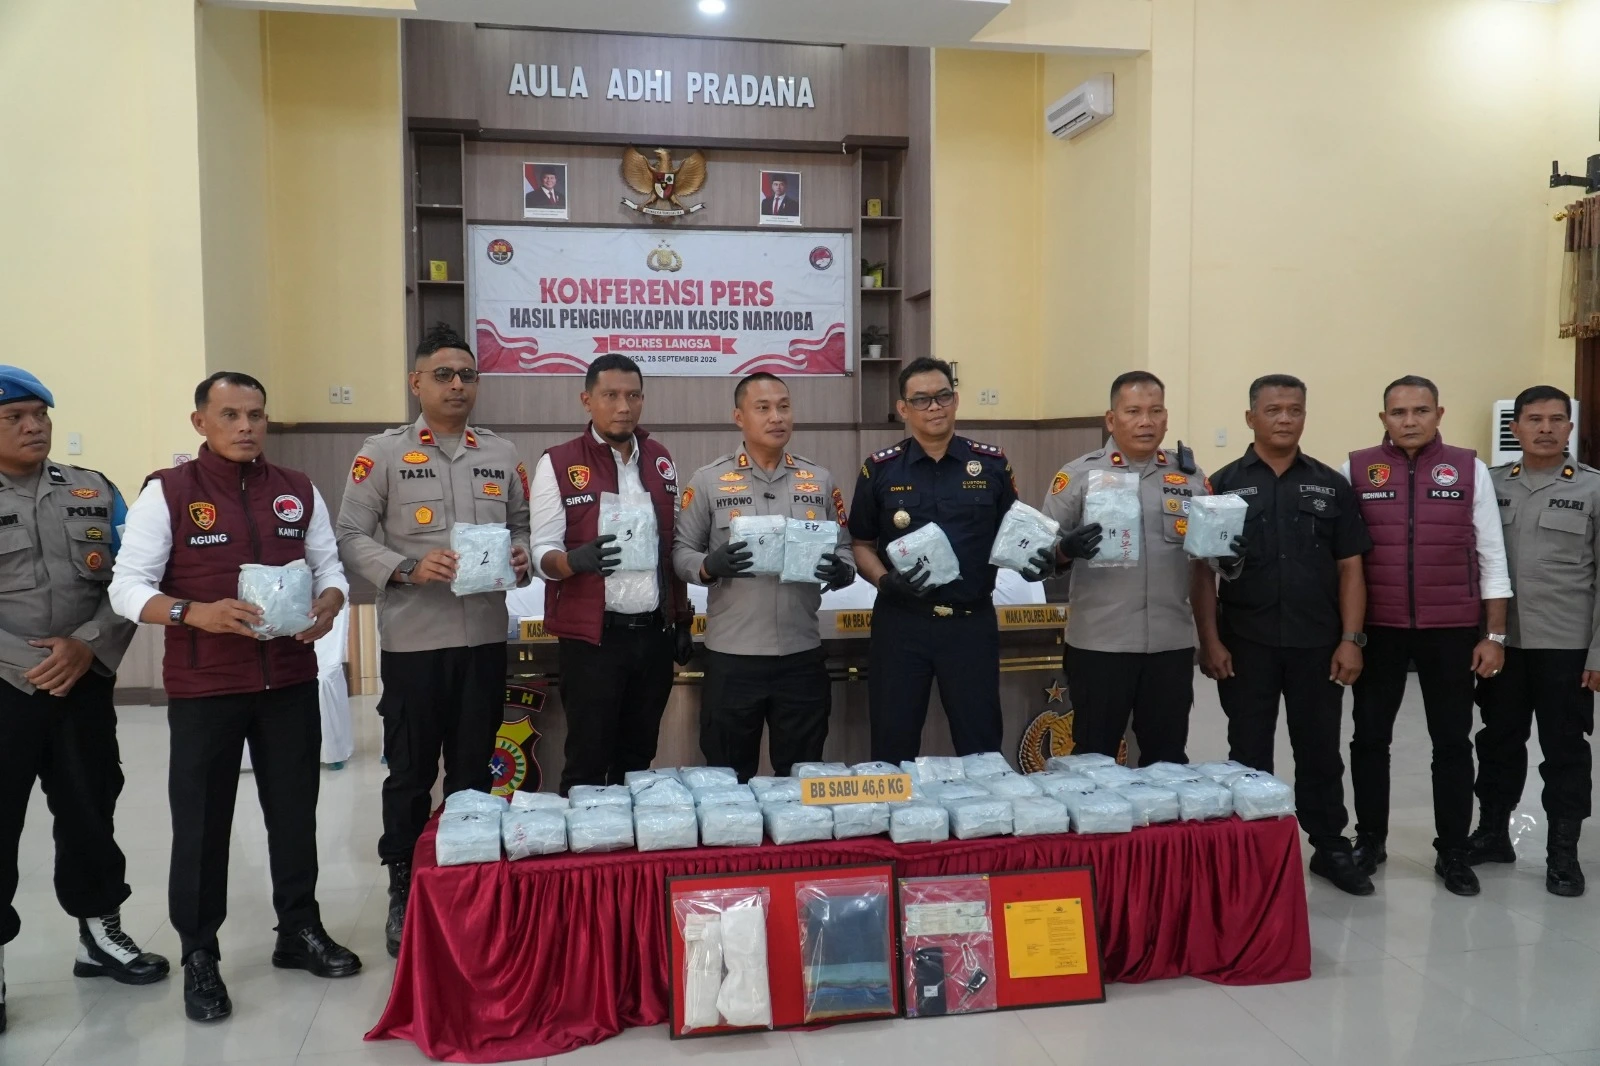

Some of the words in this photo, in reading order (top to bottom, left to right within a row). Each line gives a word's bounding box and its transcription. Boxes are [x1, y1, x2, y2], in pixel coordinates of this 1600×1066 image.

[508, 63, 589, 98] AULA
[606, 67, 672, 103] ADHI
[687, 71, 815, 108] PRADANA
[539, 278, 703, 306] KONFERENSI
[710, 280, 774, 307] PERS
[510, 307, 556, 329] HASIL
[560, 308, 684, 330] PENGUNGKAPAN
[688, 310, 739, 331] KASUS
[743, 311, 813, 331] NARKOBA
[618, 338, 663, 349] POLRES
[665, 338, 712, 349] LANGSA
[629, 355, 646, 363] GSA,
[648, 355, 656, 363] 28
[657, 355, 699, 363] SEPTEMBER
[400, 468, 436, 480] TAZIL
[473, 468, 505, 480] POLRI
[1163, 487, 1193, 498] POLRI
[1432, 490, 1460, 498] KBO
[566, 495, 594, 506] SIRYA
[716, 497, 753, 508] HYROWO
[794, 495, 824, 505] POLRI
[1548, 498, 1585, 511] POLRI
[66, 506, 108, 518] POLRI
[278, 527, 299, 538] KANIT
[624, 530, 633, 541] 3
[190, 533, 228, 545] AGUNG
[480, 551, 489, 565] 2
[852, 613, 865, 628] BEA
[1005, 609, 1022, 624] WAKA
[1023, 609, 1046, 623] POLRES
[810, 781, 826, 799] BB
[829, 780, 859, 798] SABU
[862, 779, 885, 798] 46,6
[887, 777, 904, 794] KG
